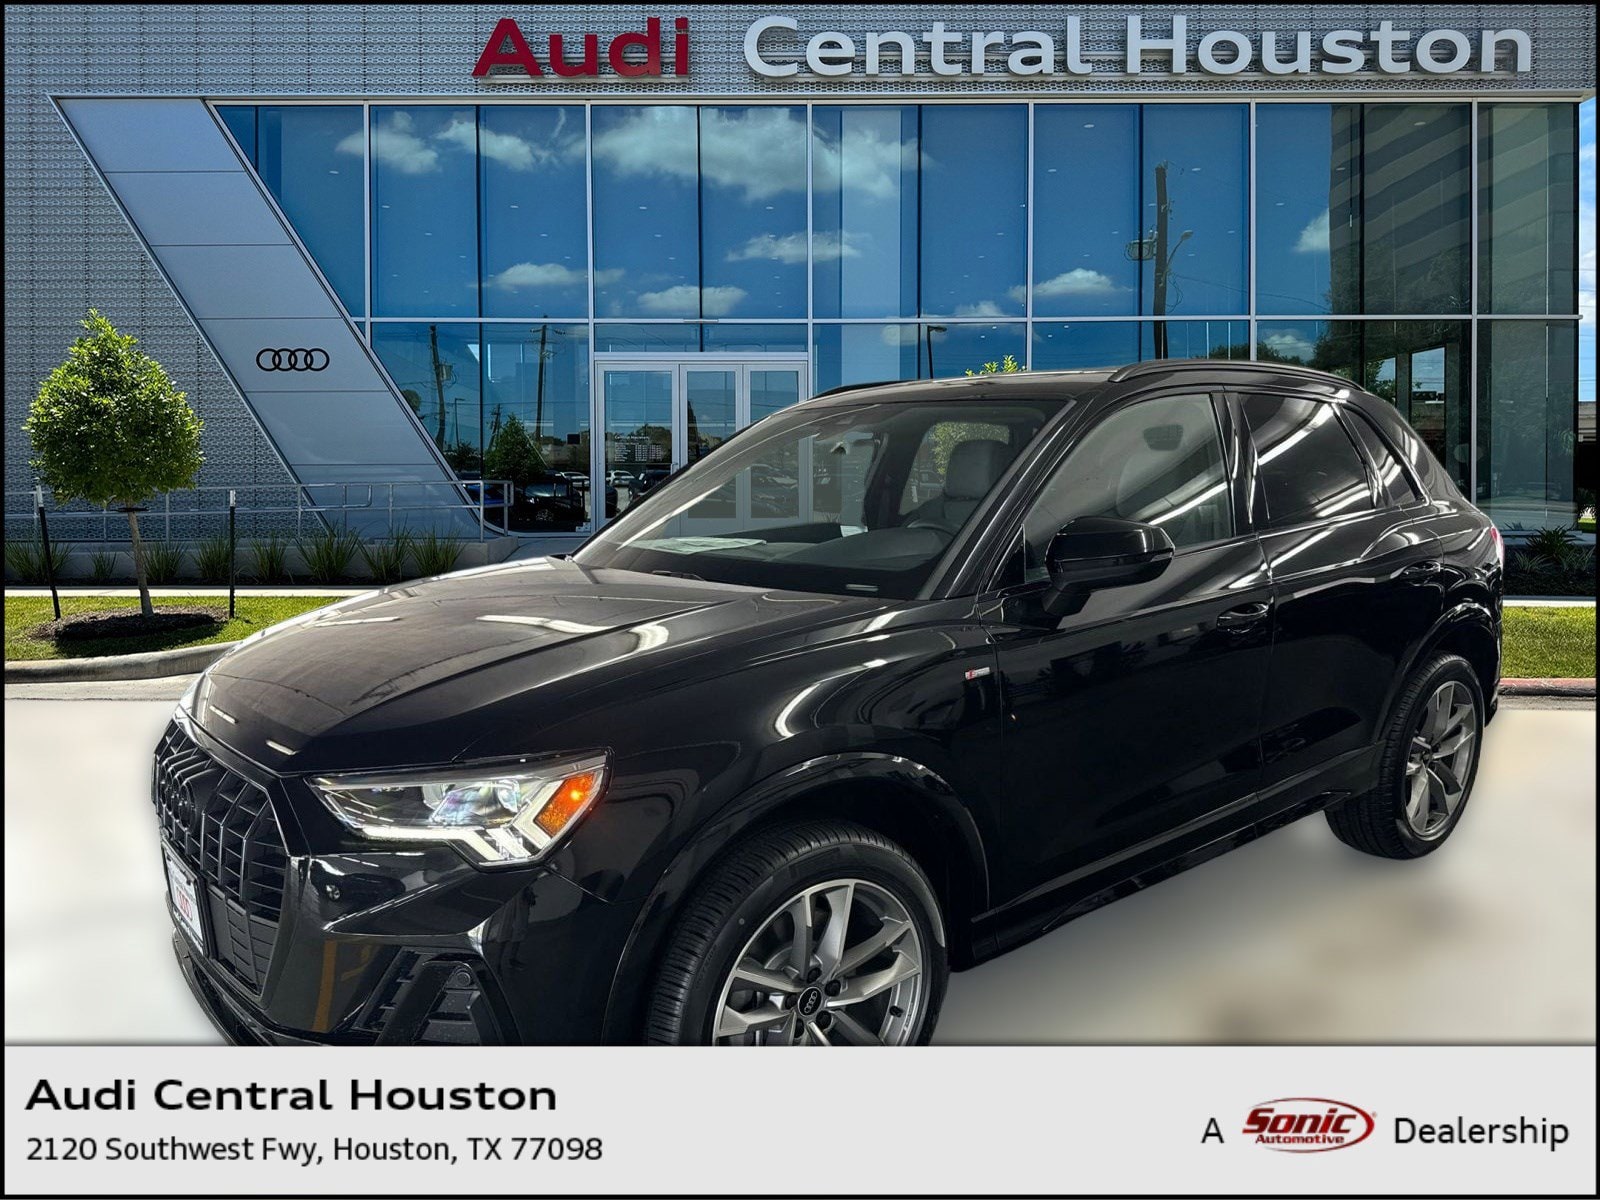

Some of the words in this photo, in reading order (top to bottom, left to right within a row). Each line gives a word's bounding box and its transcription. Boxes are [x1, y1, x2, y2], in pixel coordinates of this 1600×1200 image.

[473, 18, 689, 78] Audi
[744, 15, 1092, 77] Central
[1126, 15, 1532, 75] Houston
